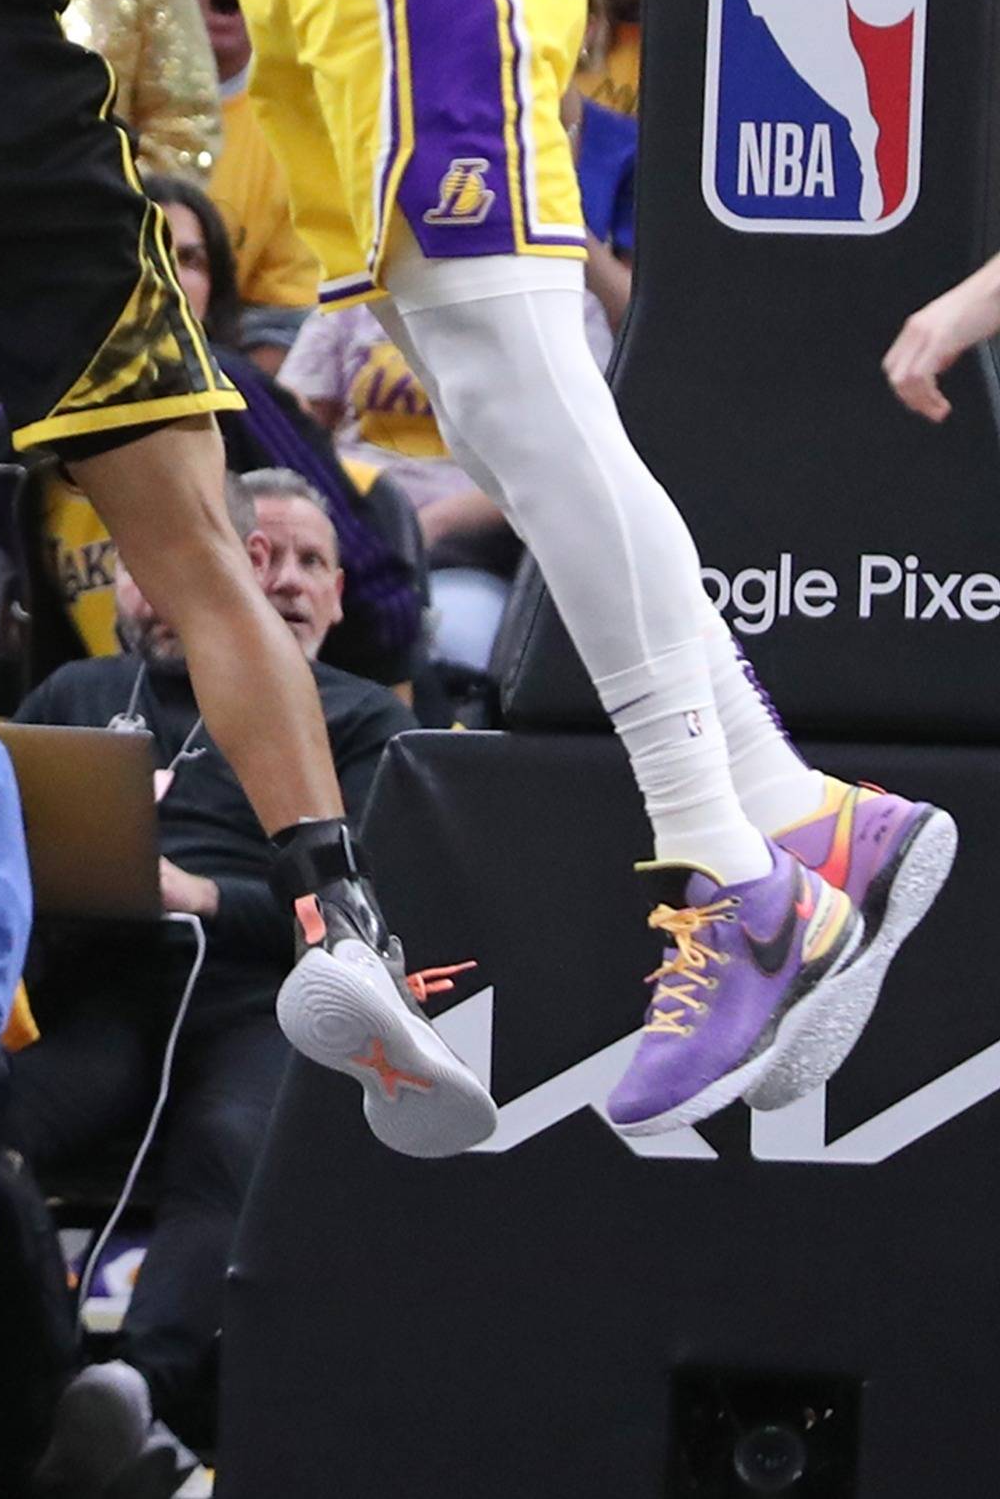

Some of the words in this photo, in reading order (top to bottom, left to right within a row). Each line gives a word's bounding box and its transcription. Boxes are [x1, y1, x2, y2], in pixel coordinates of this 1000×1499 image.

[737, 121, 836, 197] NBA
[700, 552, 838, 635] ogle
[858, 553, 1000, 622] Pixe
